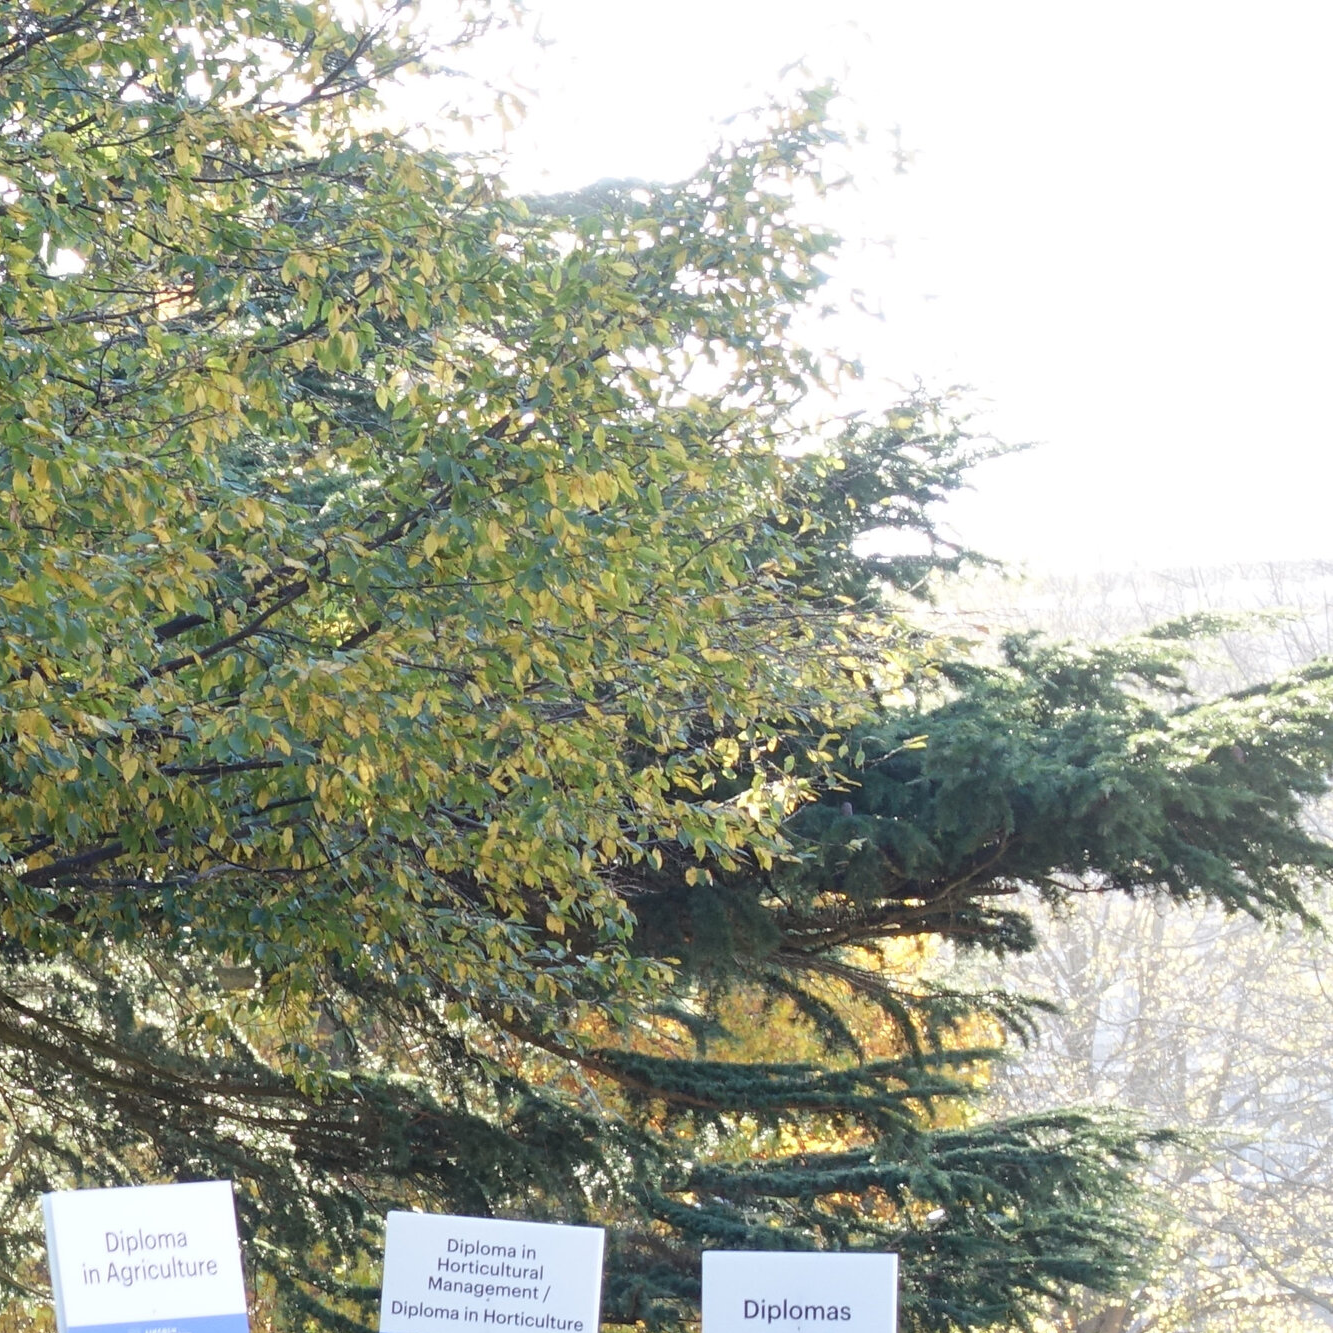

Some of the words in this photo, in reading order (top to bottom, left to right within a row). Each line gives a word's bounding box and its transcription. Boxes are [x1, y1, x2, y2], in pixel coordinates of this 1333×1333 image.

[105, 1229, 188, 1256] Diploma
[447, 1238, 516, 1259] Diploma
[521, 1244, 537, 1260] in
[82, 1263, 100, 1285] in
[107, 1257, 218, 1287] Agriculture
[437, 1258, 544, 1281] Horticultural
[428, 1276, 539, 1300] Management
[542, 1285, 551, 1303] /
[391, 1300, 459, 1320] Diploma
[464, 1306, 478, 1322] in
[483, 1308, 584, 1332] Horticulture
[743, 1298, 852, 1324] Diplomas
